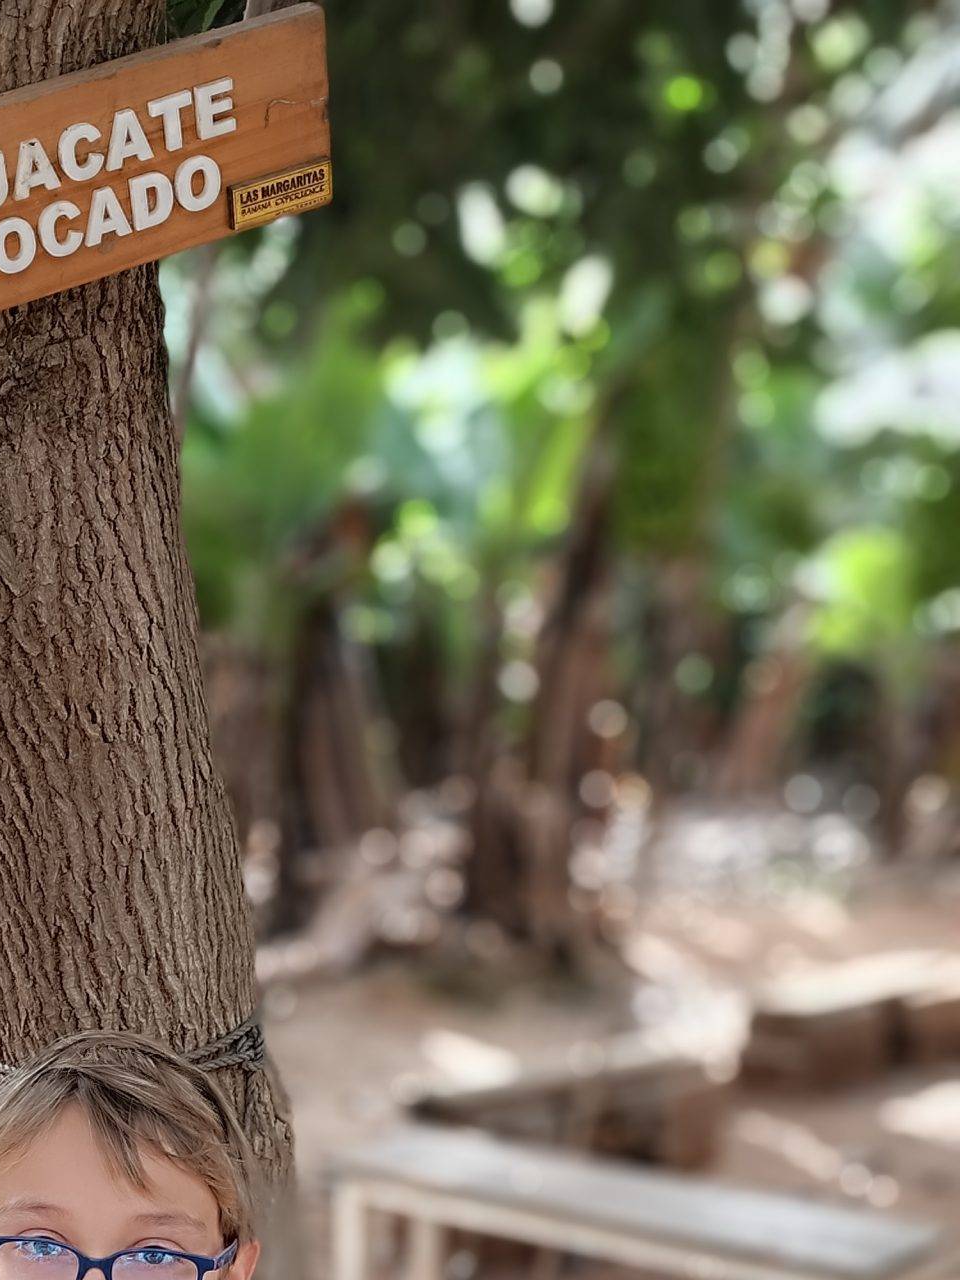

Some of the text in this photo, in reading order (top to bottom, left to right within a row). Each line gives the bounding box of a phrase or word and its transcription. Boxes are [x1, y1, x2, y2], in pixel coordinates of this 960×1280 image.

[240, 168, 325, 205] LAS MARGARITAS
[241, 202, 271, 217] BANANA
[275, 184, 325, 206] EXPERIENCE
